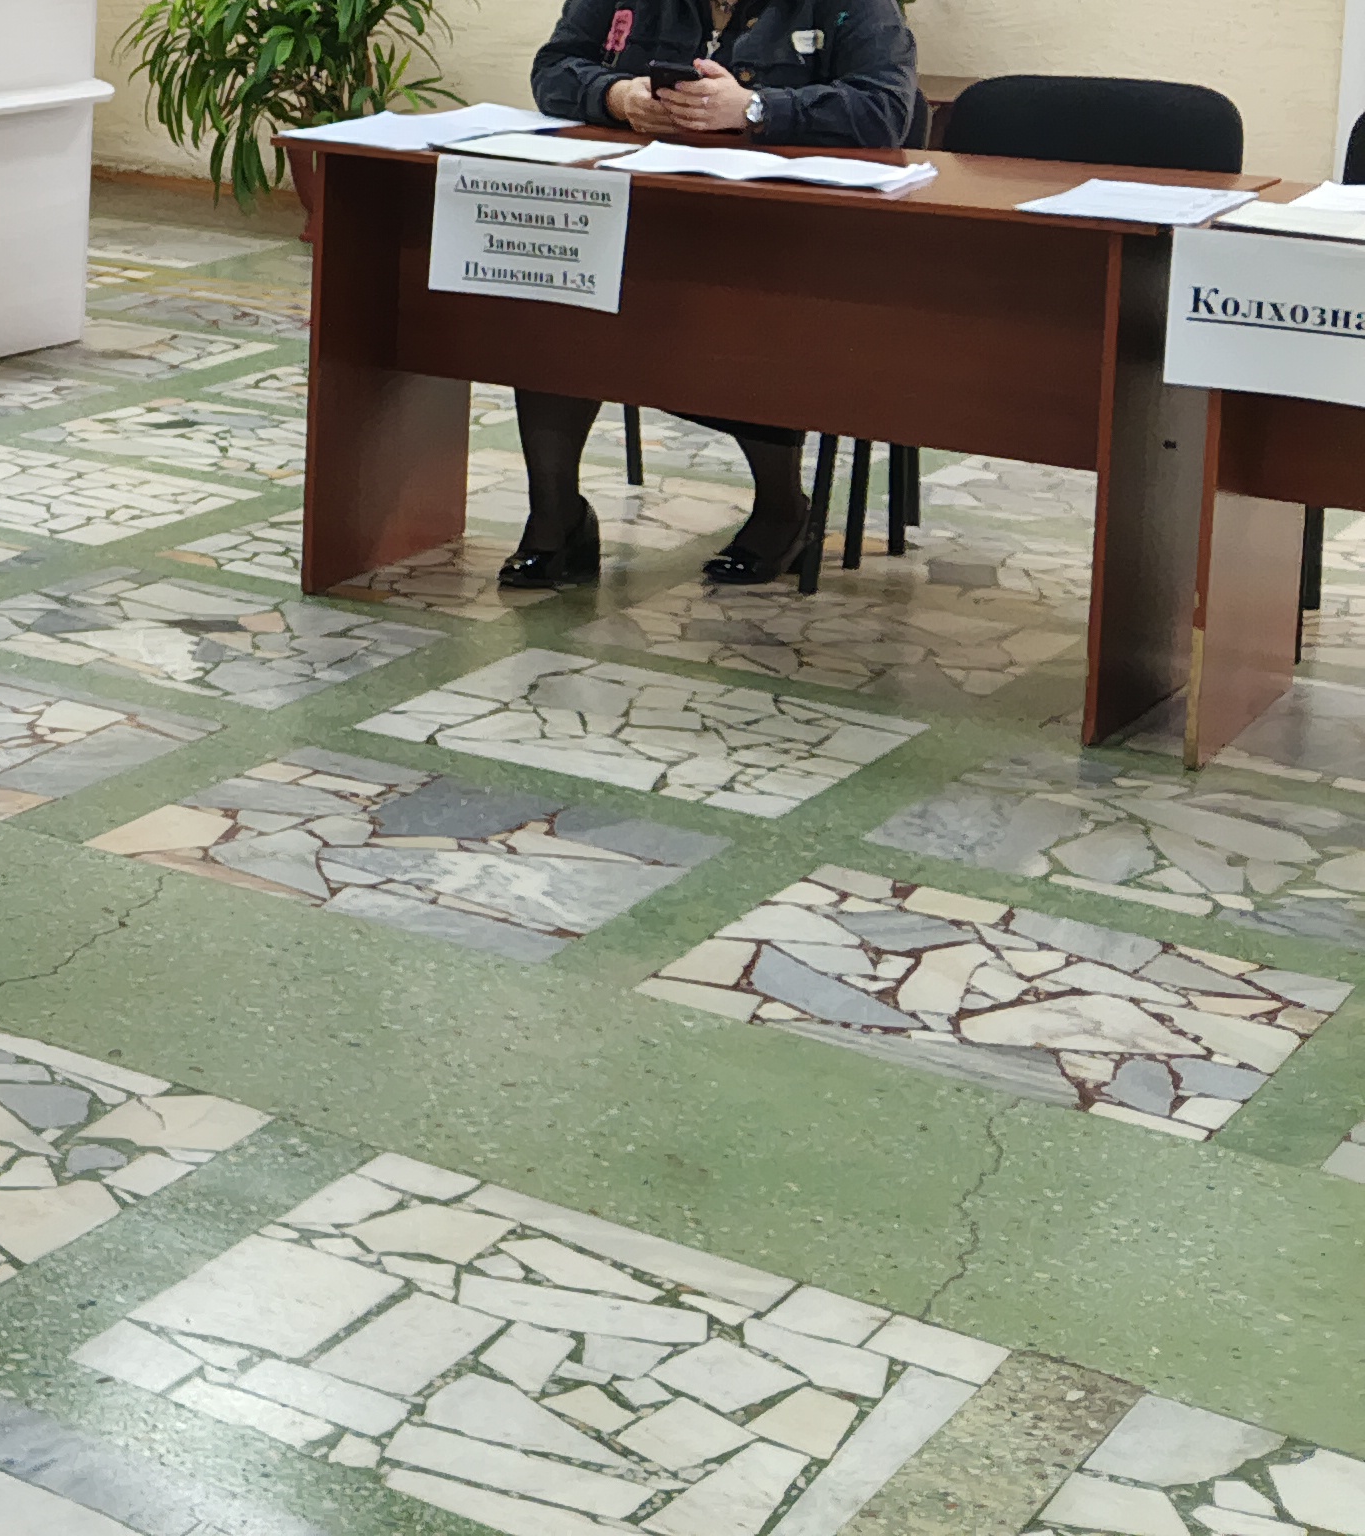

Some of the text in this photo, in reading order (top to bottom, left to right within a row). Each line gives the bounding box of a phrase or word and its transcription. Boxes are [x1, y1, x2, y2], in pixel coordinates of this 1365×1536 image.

[455, 175, 612, 202] Автомобилистов
[476, 203, 589, 228] Баумана 1-9
[484, 233, 579, 258] Заводская
[464, 261, 597, 289] Пушкина 1-35
